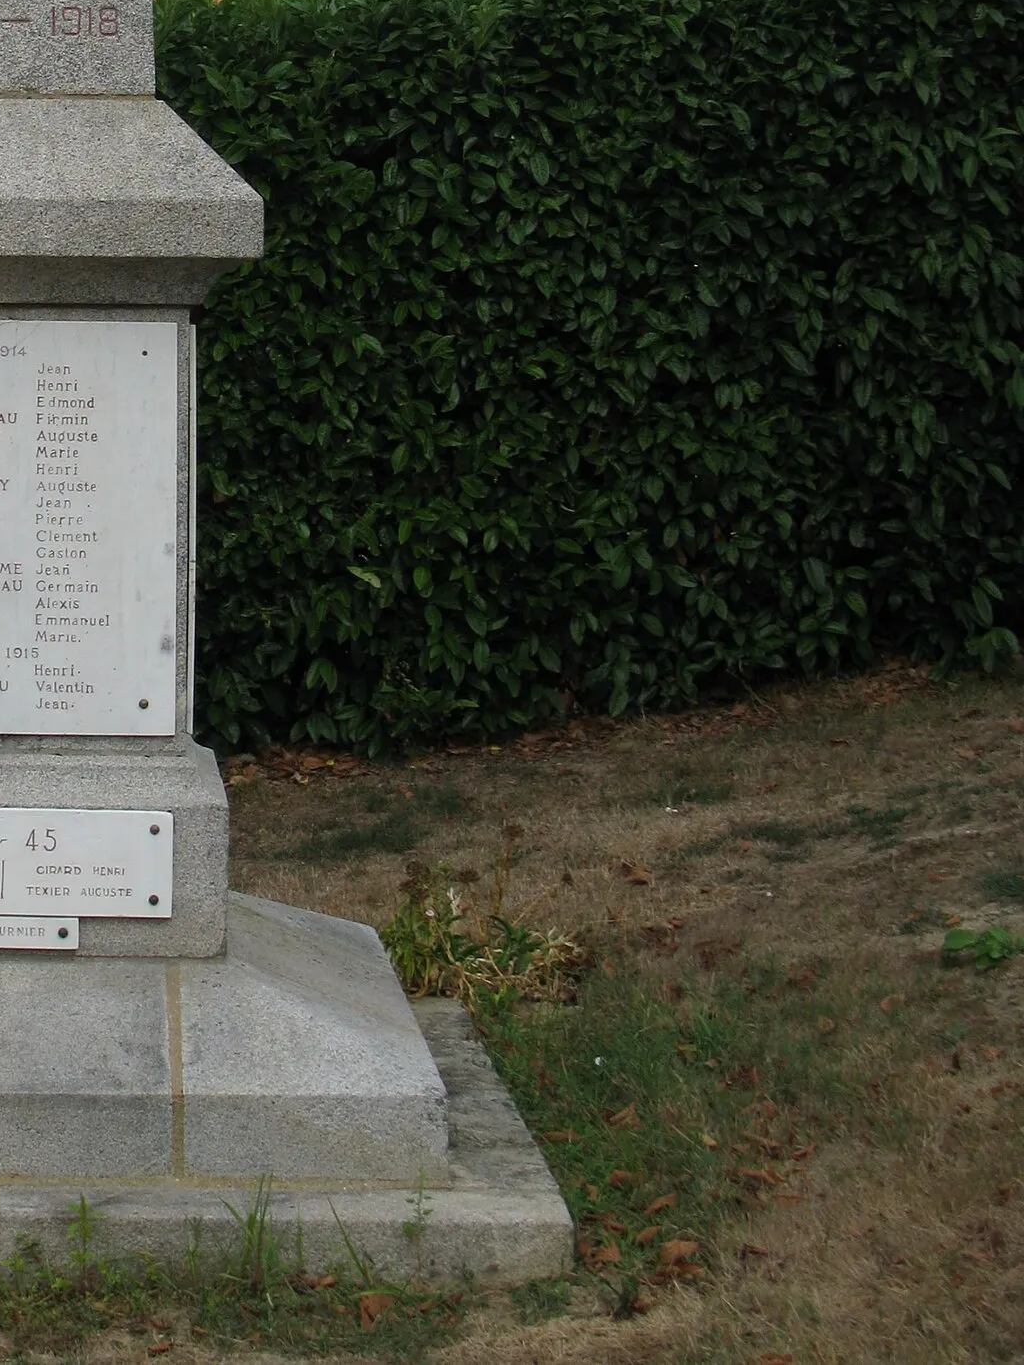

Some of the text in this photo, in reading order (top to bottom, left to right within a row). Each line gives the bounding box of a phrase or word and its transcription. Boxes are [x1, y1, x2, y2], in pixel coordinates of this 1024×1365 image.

[50, 5, 120, 37] 1918
[37, 363, 71, 375] Jean
[36, 379, 79, 392] Henri
[36, 397, 95, 409] Edmond
[36, 413, 89, 426] Firmin
[36, 430, 98, 444] Auguste
[35, 446, 79, 459] Marie
[36, 463, 79, 476] Henri
[36, 481, 97, 494] Auguste
[36, 497, 72, 509] Jean
[35, 513, 84, 526] Pierre
[35, 564, 70, 576] Jean
[35, 580, 99, 593] Germain
[35, 597, 80, 610] Alexis
[34, 614, 111, 627] Emmanuel
[5, 647, 39, 659] 1915
[36, 681, 94, 694] Valentin
[25, 828, 58, 852] 45
[92, 866, 125, 876] HENRI
[26, 886, 71, 897] TEXIER
